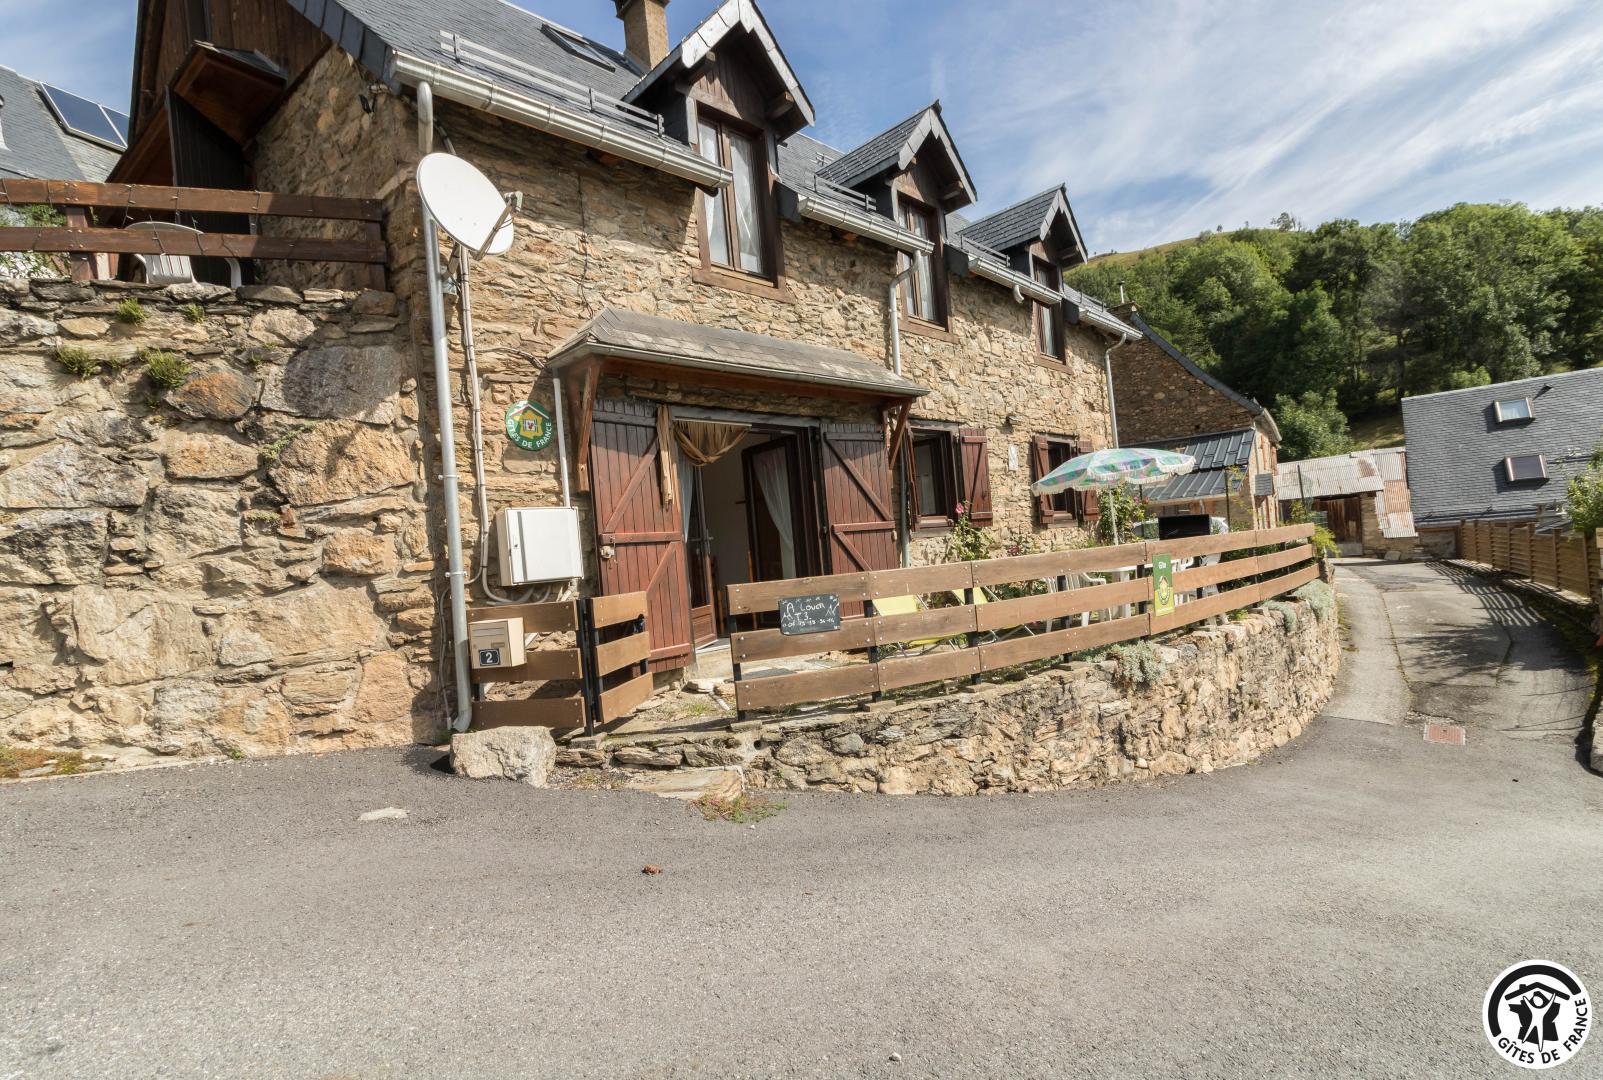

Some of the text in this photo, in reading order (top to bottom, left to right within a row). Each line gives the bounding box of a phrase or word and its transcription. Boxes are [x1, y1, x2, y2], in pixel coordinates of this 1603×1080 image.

[522, 440, 533, 448] DE
[536, 422, 552, 447] FRANCE
[485, 652, 493, 663] 2
